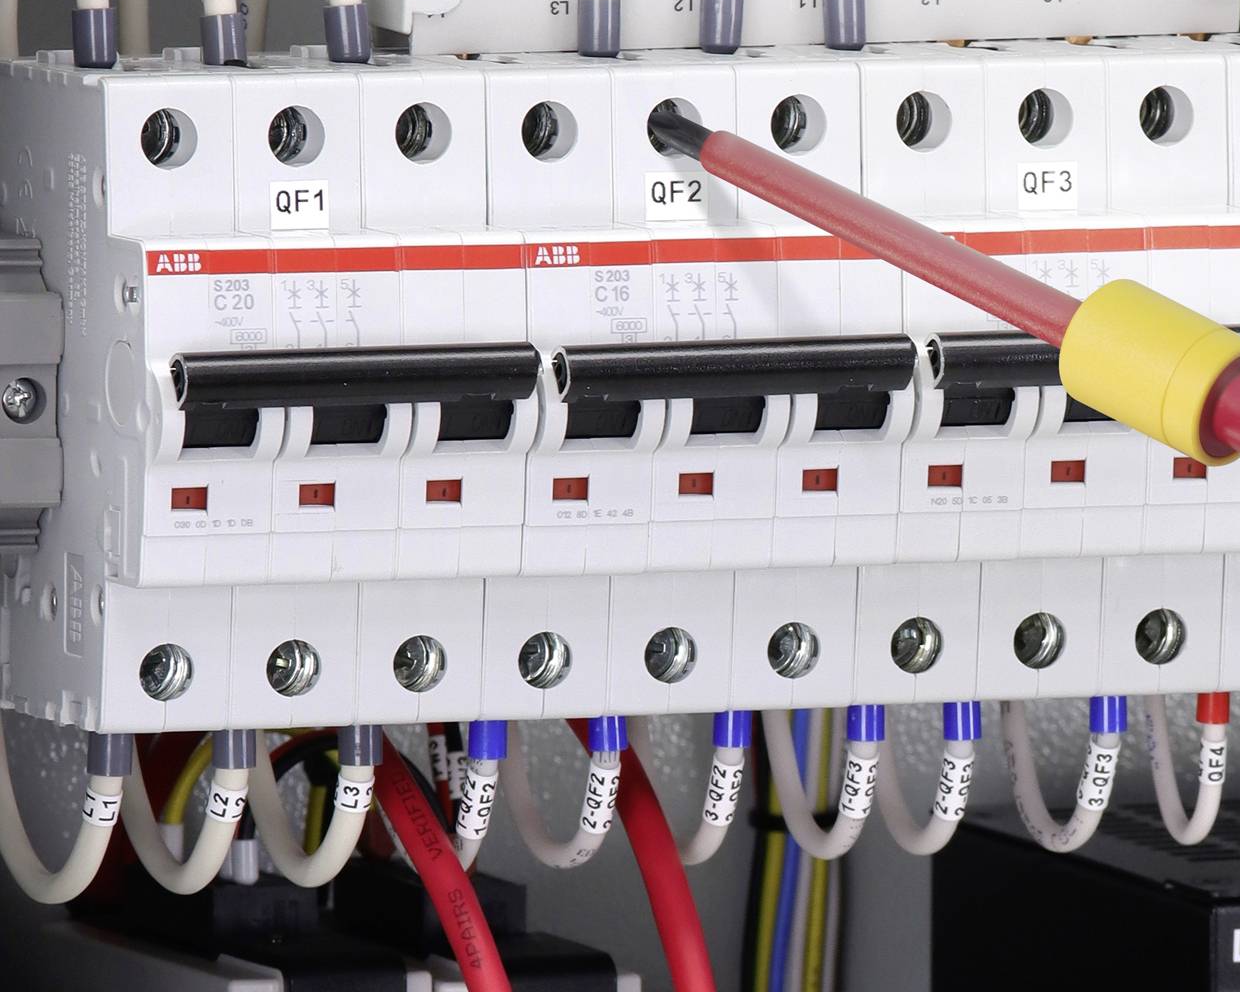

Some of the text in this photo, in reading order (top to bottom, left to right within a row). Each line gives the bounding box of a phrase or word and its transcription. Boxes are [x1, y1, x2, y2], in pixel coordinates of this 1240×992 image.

[550, 1, 569, 15] L3
[651, 180, 702, 205] QF2
[1023, 171, 1073, 195] QF3
[276, 189, 324, 214] QF1
[155, 253, 202, 272] ABB
[535, 246, 580, 265] ABB
[1208, 746, 1225, 782] QF4
[706, 765, 726, 821] 3-QF2
[842, 761, 862, 812] 1-QF3
[936, 759, 956, 815] 2-QF3
[1088, 754, 1112, 806] 3-QF3
[211, 792, 229, 818] L2
[341, 786, 360, 809] L3
[474, 781, 497, 835] 1-QF2
[583, 773, 605, 829] 2-QF2
[99, 800, 117, 822] L1
[449, 888, 483, 968] 4PAIRS
